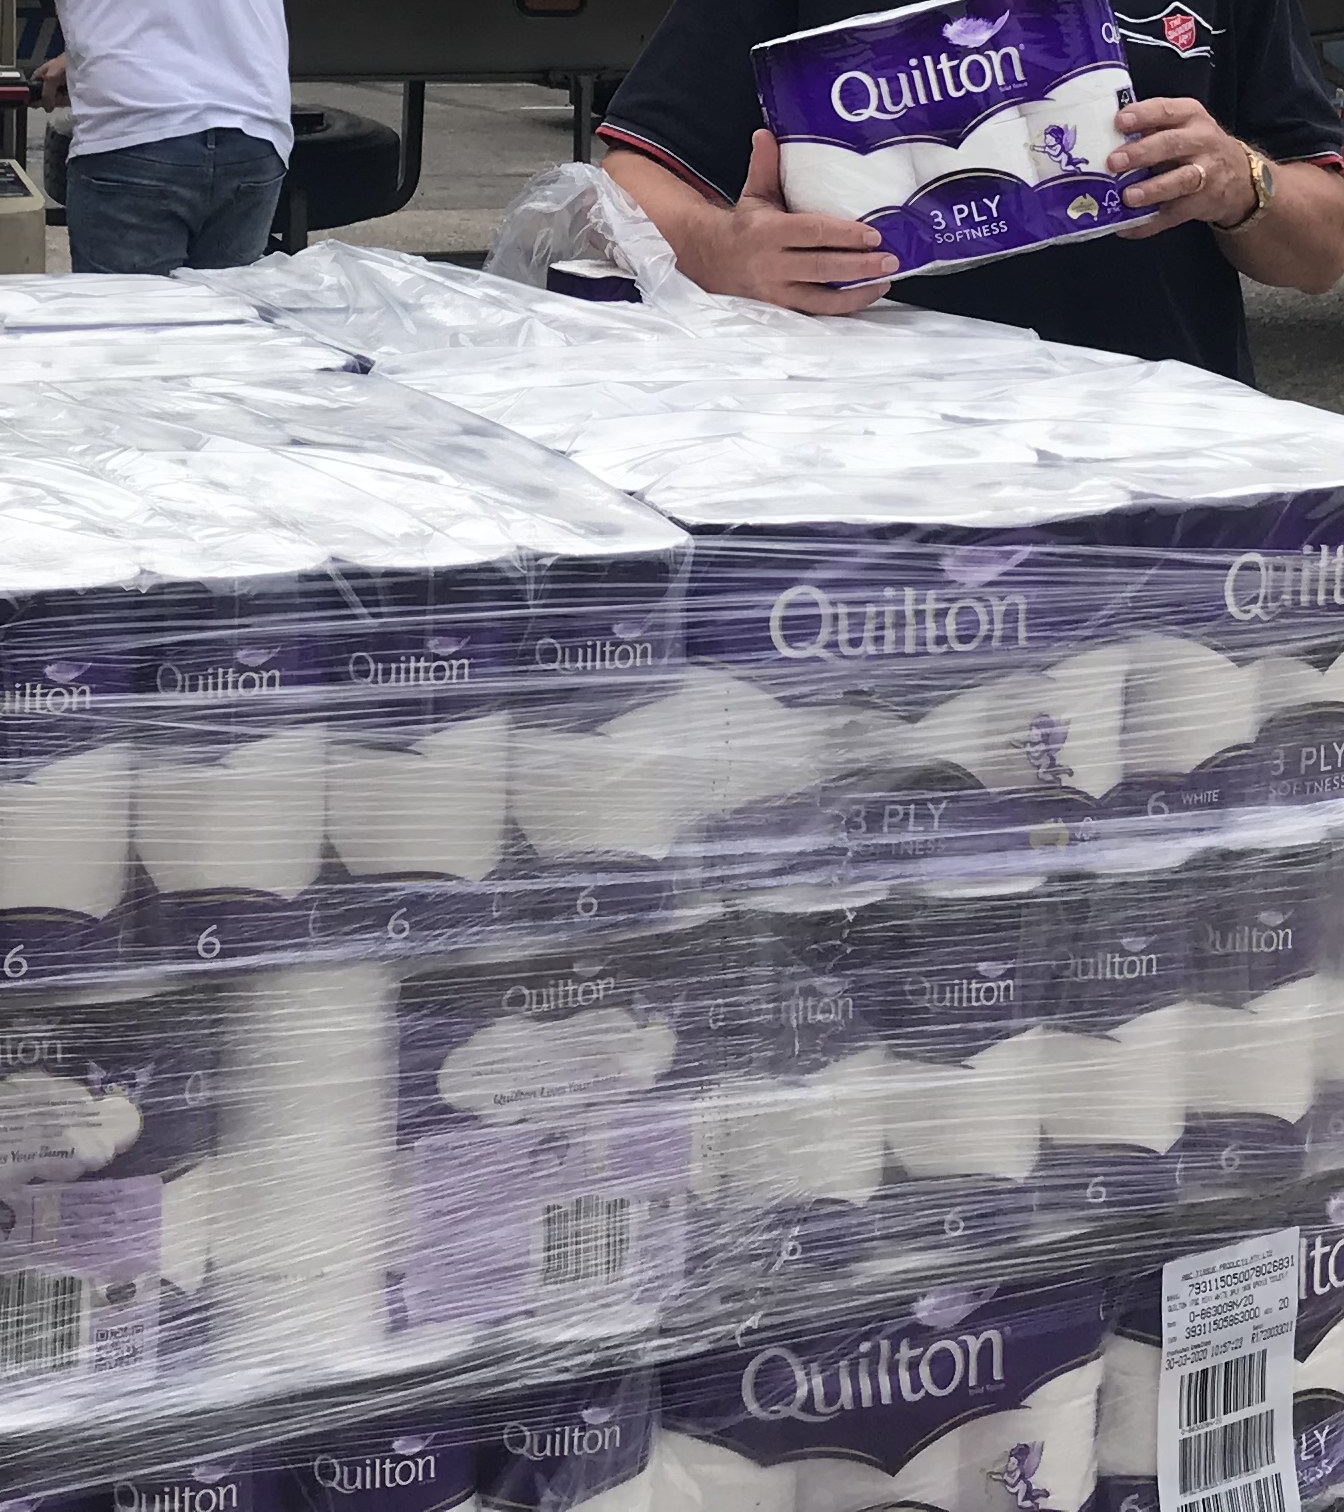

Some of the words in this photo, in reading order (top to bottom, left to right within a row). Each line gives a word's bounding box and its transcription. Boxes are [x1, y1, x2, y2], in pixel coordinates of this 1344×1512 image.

[831, 46, 1027, 123] Quilton
[930, 210, 947, 231] 3
[952, 194, 1002, 227] PLY
[934, 220, 1008, 245] SOFTNESS
[768, 584, 1029, 660] Quilton
[349, 651, 471, 688] Quilton
[535, 637, 653, 675] Quilton
[157, 662, 282, 698] Quilton
[1181, 789, 1219, 806] WHITE
[882, 799, 949, 834] PLY
[576, 883, 599, 917] 6
[387, 906, 410, 940] 6
[197, 924, 222, 958] 6
[3, 944, 29, 978] 6
[501, 976, 615, 1012] Quilton
[905, 977, 1015, 1012] Quilton
[1221, 1148, 1240, 1173] 6
[1088, 1176, 1107, 1204] 6
[1278, 1296, 1290, 1311] 20
[741, 1326, 1006, 1424] Quilton
[504, 1420, 621, 1462] Quilton
[1300, 1424, 1331, 1462] LY
[314, 1451, 438, 1494] Quilton
[113, 1479, 239, 1512] Quilton
